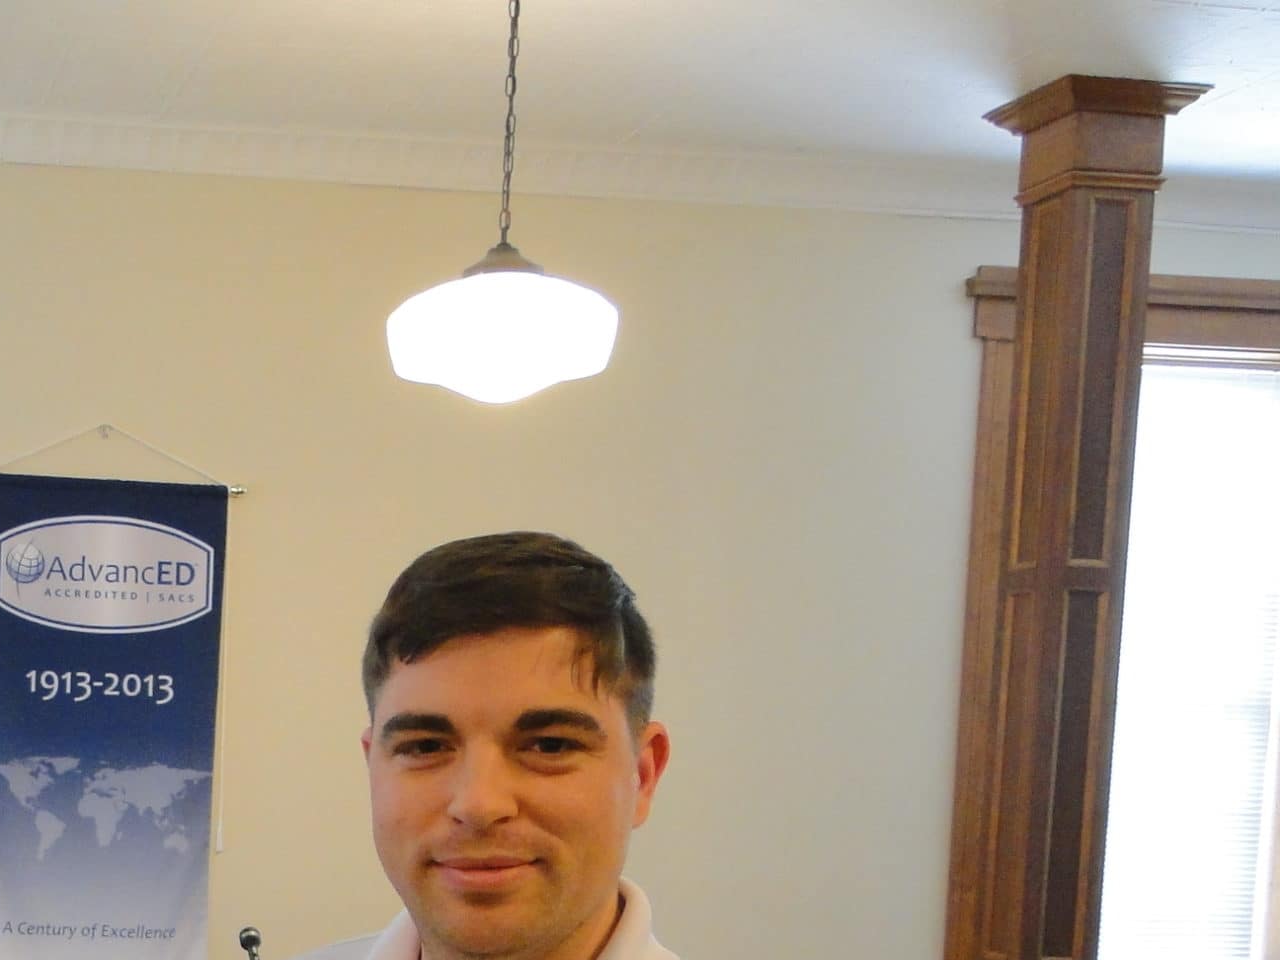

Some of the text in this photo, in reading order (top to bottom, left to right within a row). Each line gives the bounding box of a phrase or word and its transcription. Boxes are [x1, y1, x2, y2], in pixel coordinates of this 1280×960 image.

[46, 555, 196, 587] AdvancED
[44, 588, 195, 603] ACCREDITED SACS
[25, 669, 175, 705] 1913-2013
[1, 921, 177, 940] A Century of Excellence
